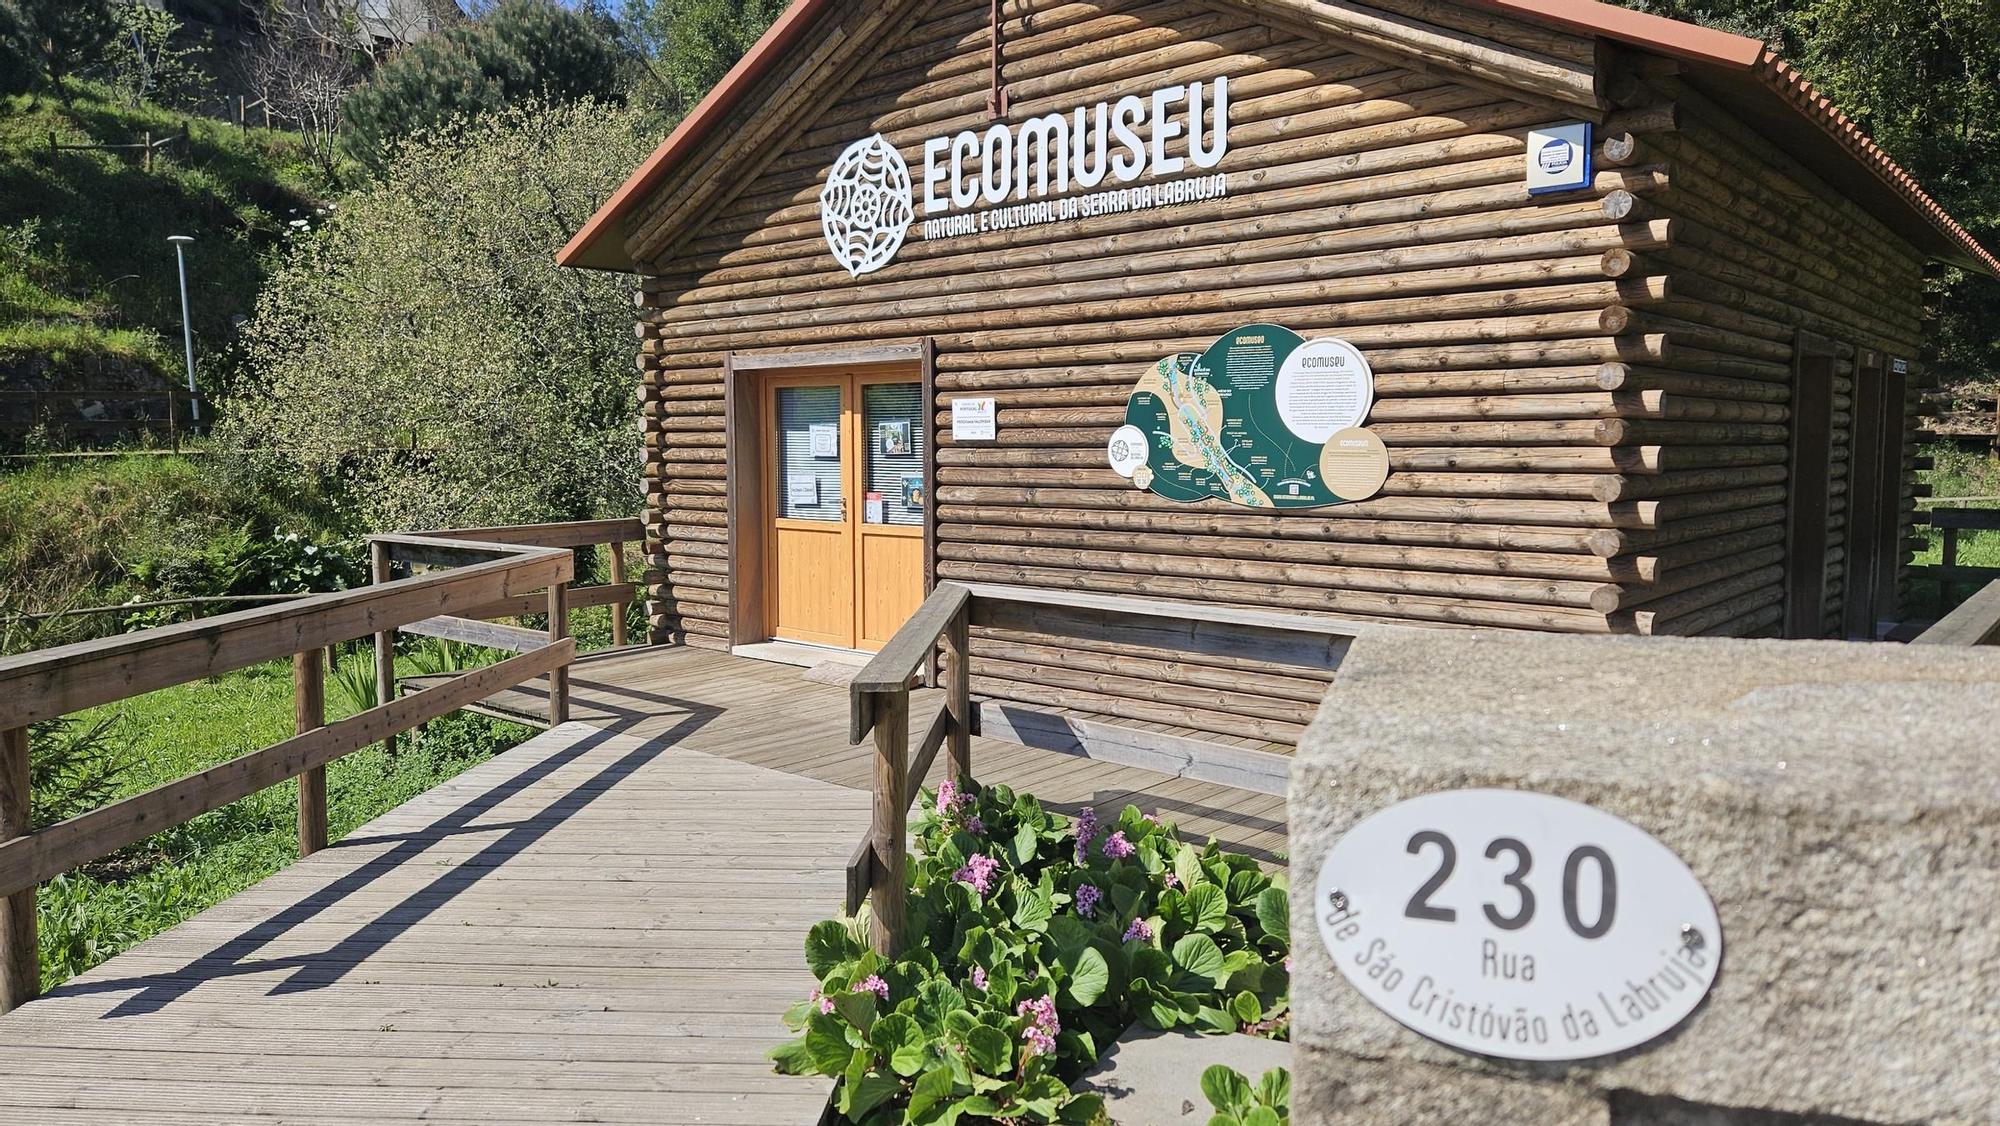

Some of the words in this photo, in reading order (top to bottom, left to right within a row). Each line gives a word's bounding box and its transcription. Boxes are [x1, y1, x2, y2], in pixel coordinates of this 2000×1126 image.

[924, 76, 1228, 213] ECOMUSEU
[924, 213, 978, 240] NATURAL
[981, 210, 989, 232] E
[991, 200, 1056, 230] CULTURAL
[1059, 196, 1078, 220] DA
[1081, 189, 1128, 217] SERRA
[1132, 185, 1151, 209] DA
[1155, 172, 1226, 206] LABRUJA
[1404, 830, 1618, 940] 230
[1326, 909, 1360, 941] de
[1408, 975, 1549, 1045] Cristóvão
[1561, 1003, 1599, 1043] da
[1598, 944, 1707, 1028] Labruja
[1482, 938, 1536, 982] Rua
